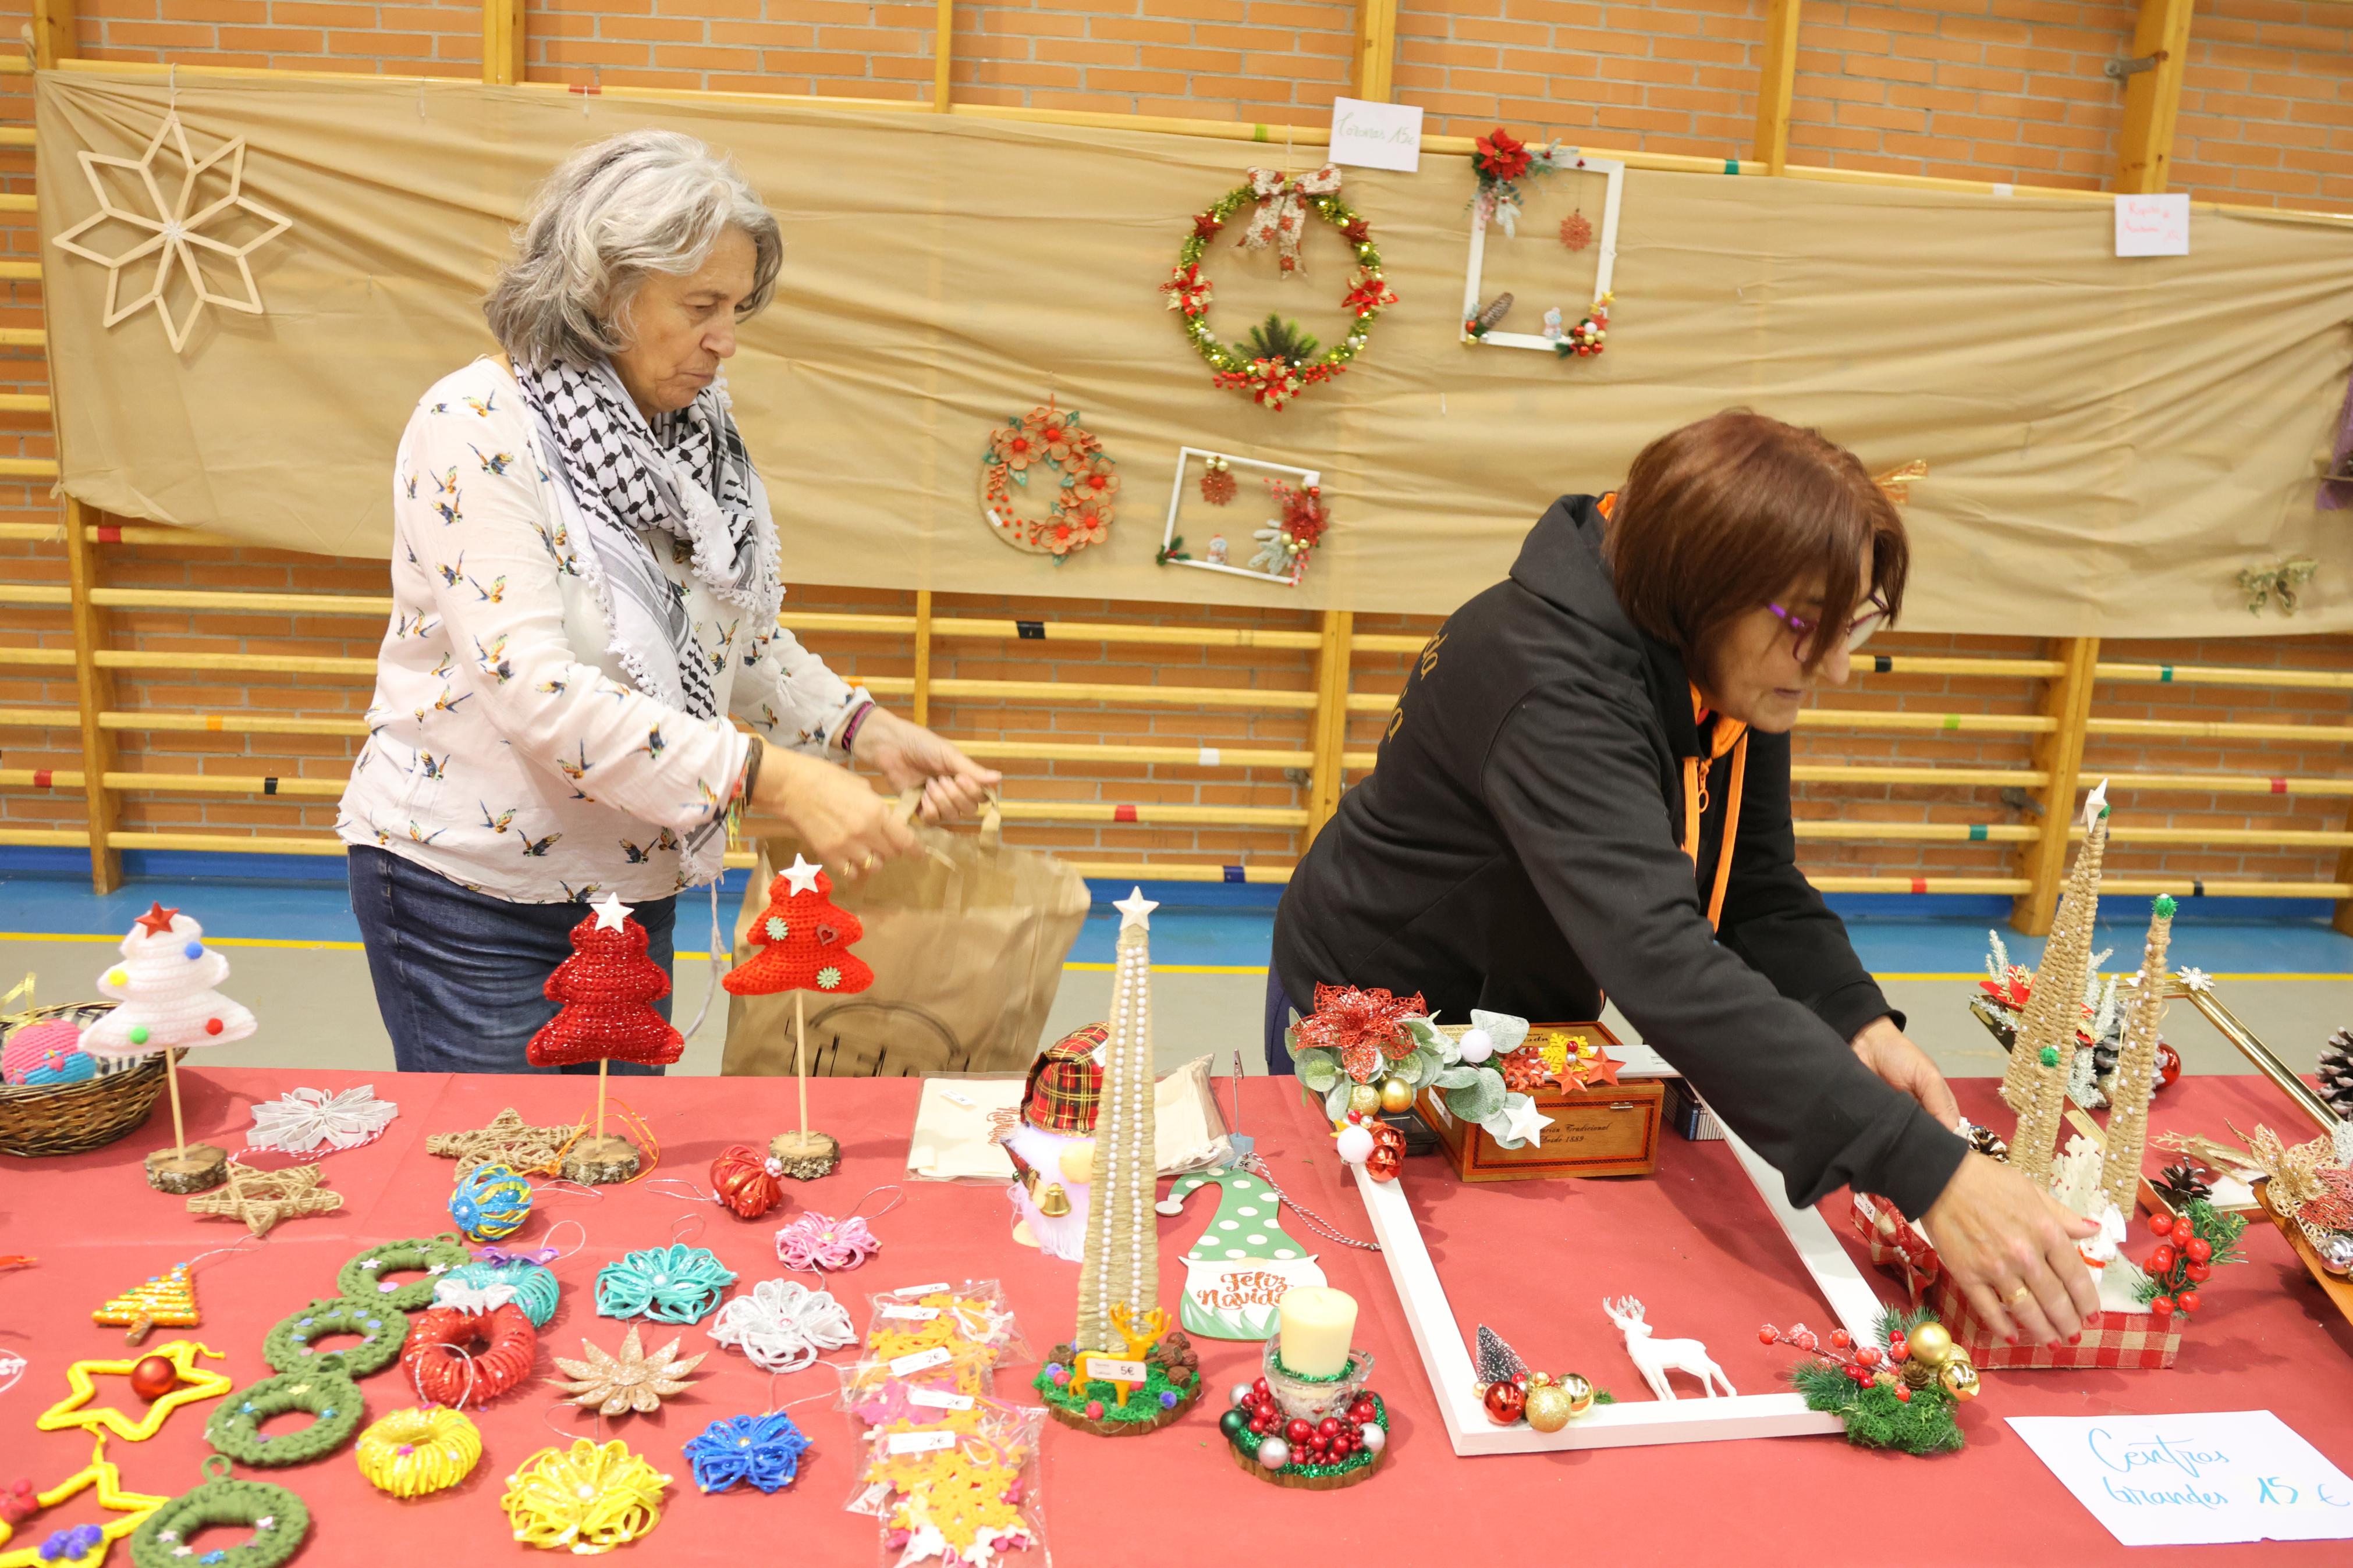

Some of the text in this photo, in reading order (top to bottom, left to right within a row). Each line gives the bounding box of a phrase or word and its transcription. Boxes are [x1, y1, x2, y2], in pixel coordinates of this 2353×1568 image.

[1565, 1122, 1613, 1132] Tradicional
[1220, 1271, 1294, 1292] Feliz
[926, 1353, 942, 1363] 2€
[1120, 1366, 1135, 1375] 5€
[947, 1399, 963, 1407] 2€
[929, 1437, 945, 1446] 2€
[2088, 1428, 2230, 1478] Centros
